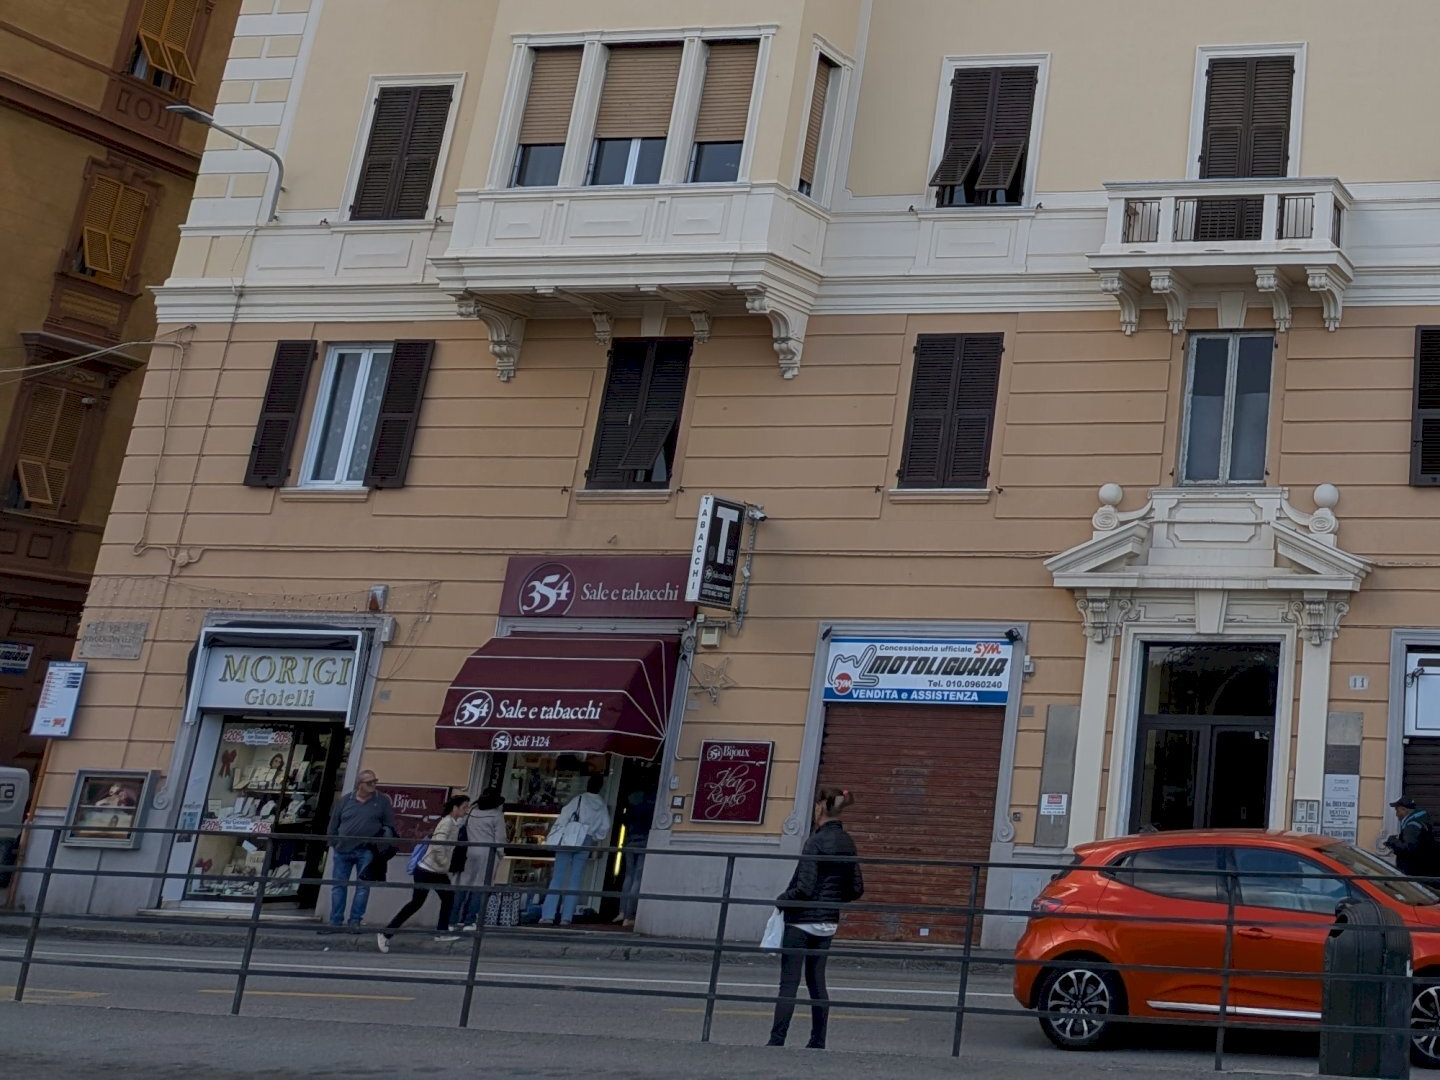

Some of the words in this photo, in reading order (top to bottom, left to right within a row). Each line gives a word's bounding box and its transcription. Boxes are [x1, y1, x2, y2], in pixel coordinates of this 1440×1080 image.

[691, 496, 710, 590] TABACCHI
[716, 505, 740, 565] T
[522, 572, 571, 613] 354
[581, 582, 609, 601] Sale
[610, 589, 619, 601] e
[621, 582, 680, 601] tabacchi
[879, 644, 939, 653] Concessionaria
[940, 644, 973, 653] ufficiale
[974, 642, 1002, 657] SYM
[218, 654, 352, 686] MORIGI
[867, 655, 1009, 677] MOTOLIGURIA
[928, 679, 944, 688] Tel.
[244, 688, 316, 707] Gioielli
[852, 689, 899, 700] VENDITA
[901, 692, 908, 700] e
[910, 690, 979, 701] ASSISTENZA
[496, 699, 526, 719] Sale
[528, 707, 538, 719] e
[540, 700, 603, 720] tabacchi
[513, 735, 530, 747] Self
[530, 736, 550, 747] H24
[722, 745, 750, 760] Bijoux
[392, 793, 427, 813] Bijoux
